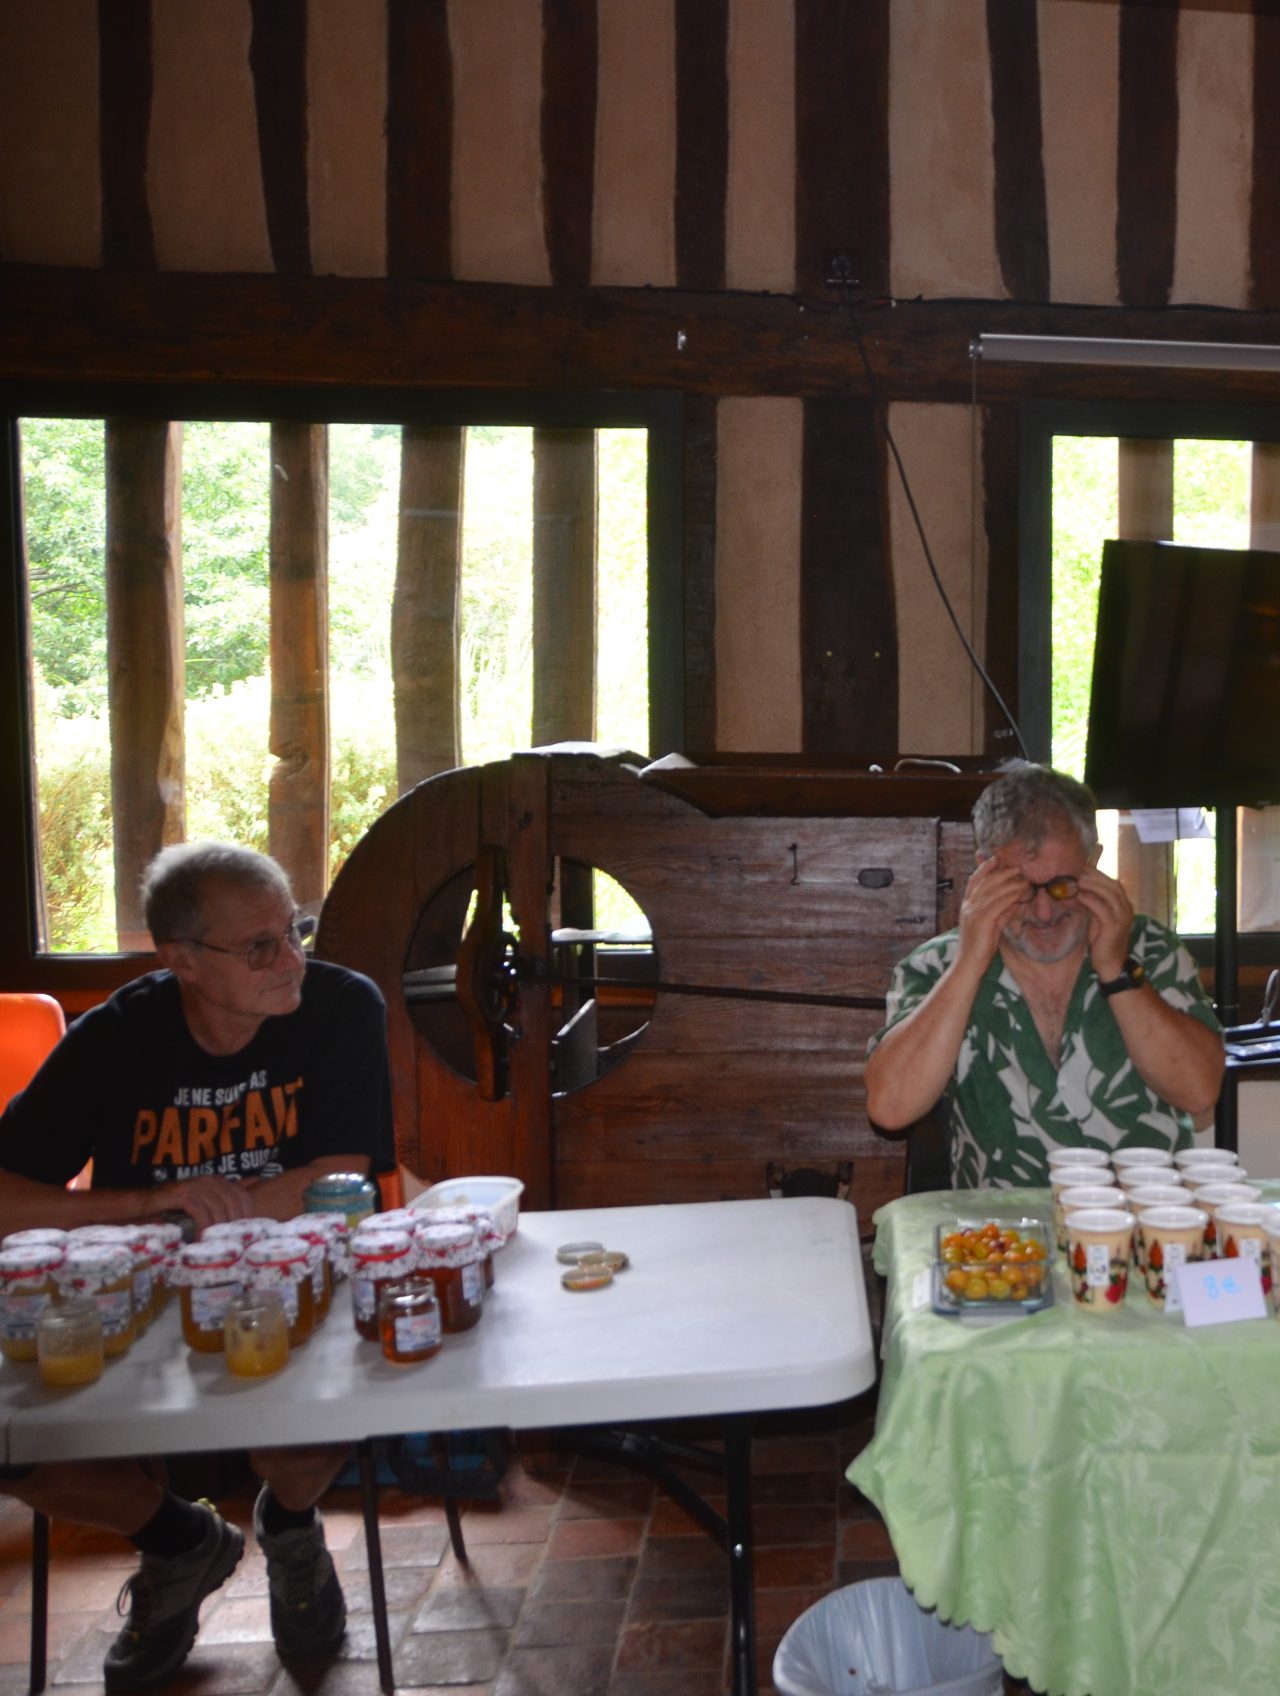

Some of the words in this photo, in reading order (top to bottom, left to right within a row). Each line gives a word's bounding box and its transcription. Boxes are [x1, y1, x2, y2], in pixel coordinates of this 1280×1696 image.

[174, 1087, 190, 1106] JE
[192, 1087, 212, 1106] NE
[249, 1069, 267, 1089] AS
[131, 1075, 303, 1166] PARFAIT
[176, 1160, 214, 1181] MAIS
[218, 1153, 238, 1174] JE
